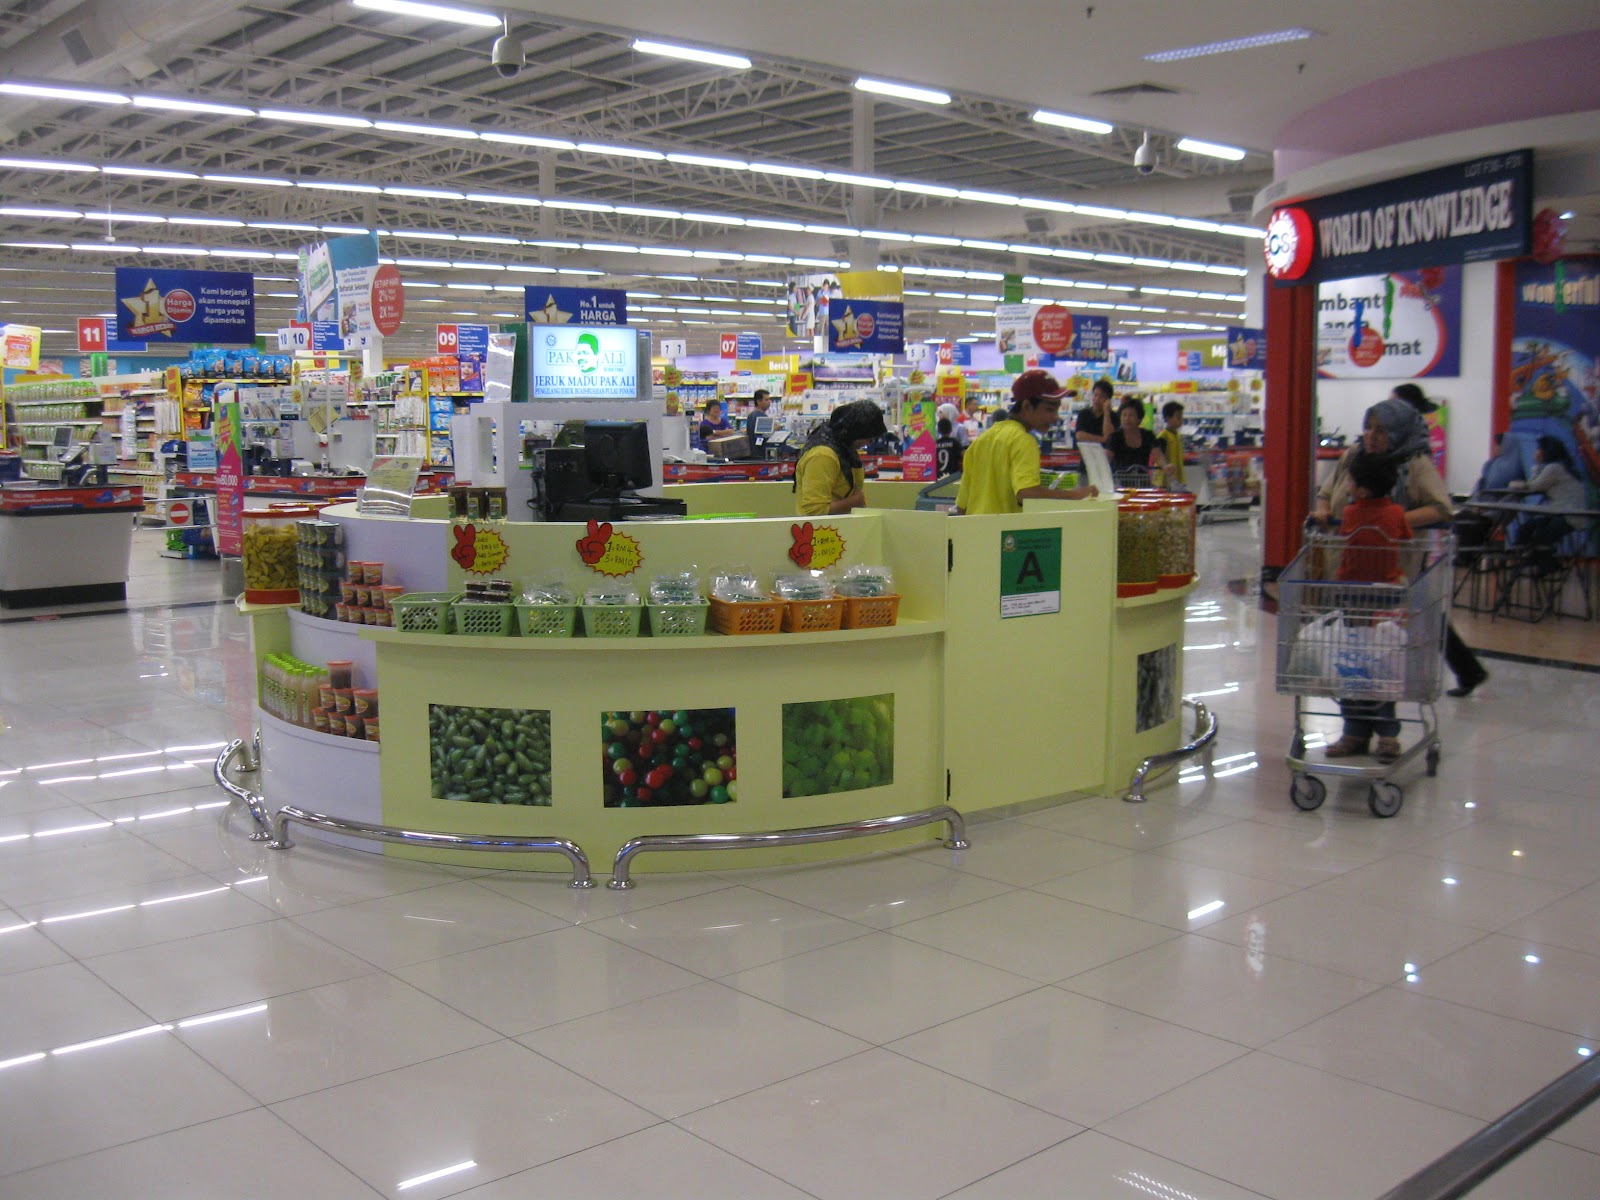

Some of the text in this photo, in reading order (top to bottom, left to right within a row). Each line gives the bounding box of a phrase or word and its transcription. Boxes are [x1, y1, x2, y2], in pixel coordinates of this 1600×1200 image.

[1319, 180, 1514, 258] WORLD OF KNOWLEDGE
[201, 287, 248, 297] Kami berjanji
[167, 298, 192, 307] Harga
[216, 299, 250, 307] menepati
[205, 307, 245, 316] harga yang
[581, 310, 616, 321] HARGA
[203, 316, 246, 325] dipamerkan
[83, 327, 100, 342] 11
[293, 332, 304, 344] 10
[439, 332, 457, 346] 09
[722, 341, 736, 353] 07
[549, 351, 623, 364] PAK ALI
[940, 348, 952, 359] 05
[535, 375, 635, 388] JERUK MADU PAK ALI
[938, 449, 949, 471] 9
[1017, 551, 1046, 585] A
